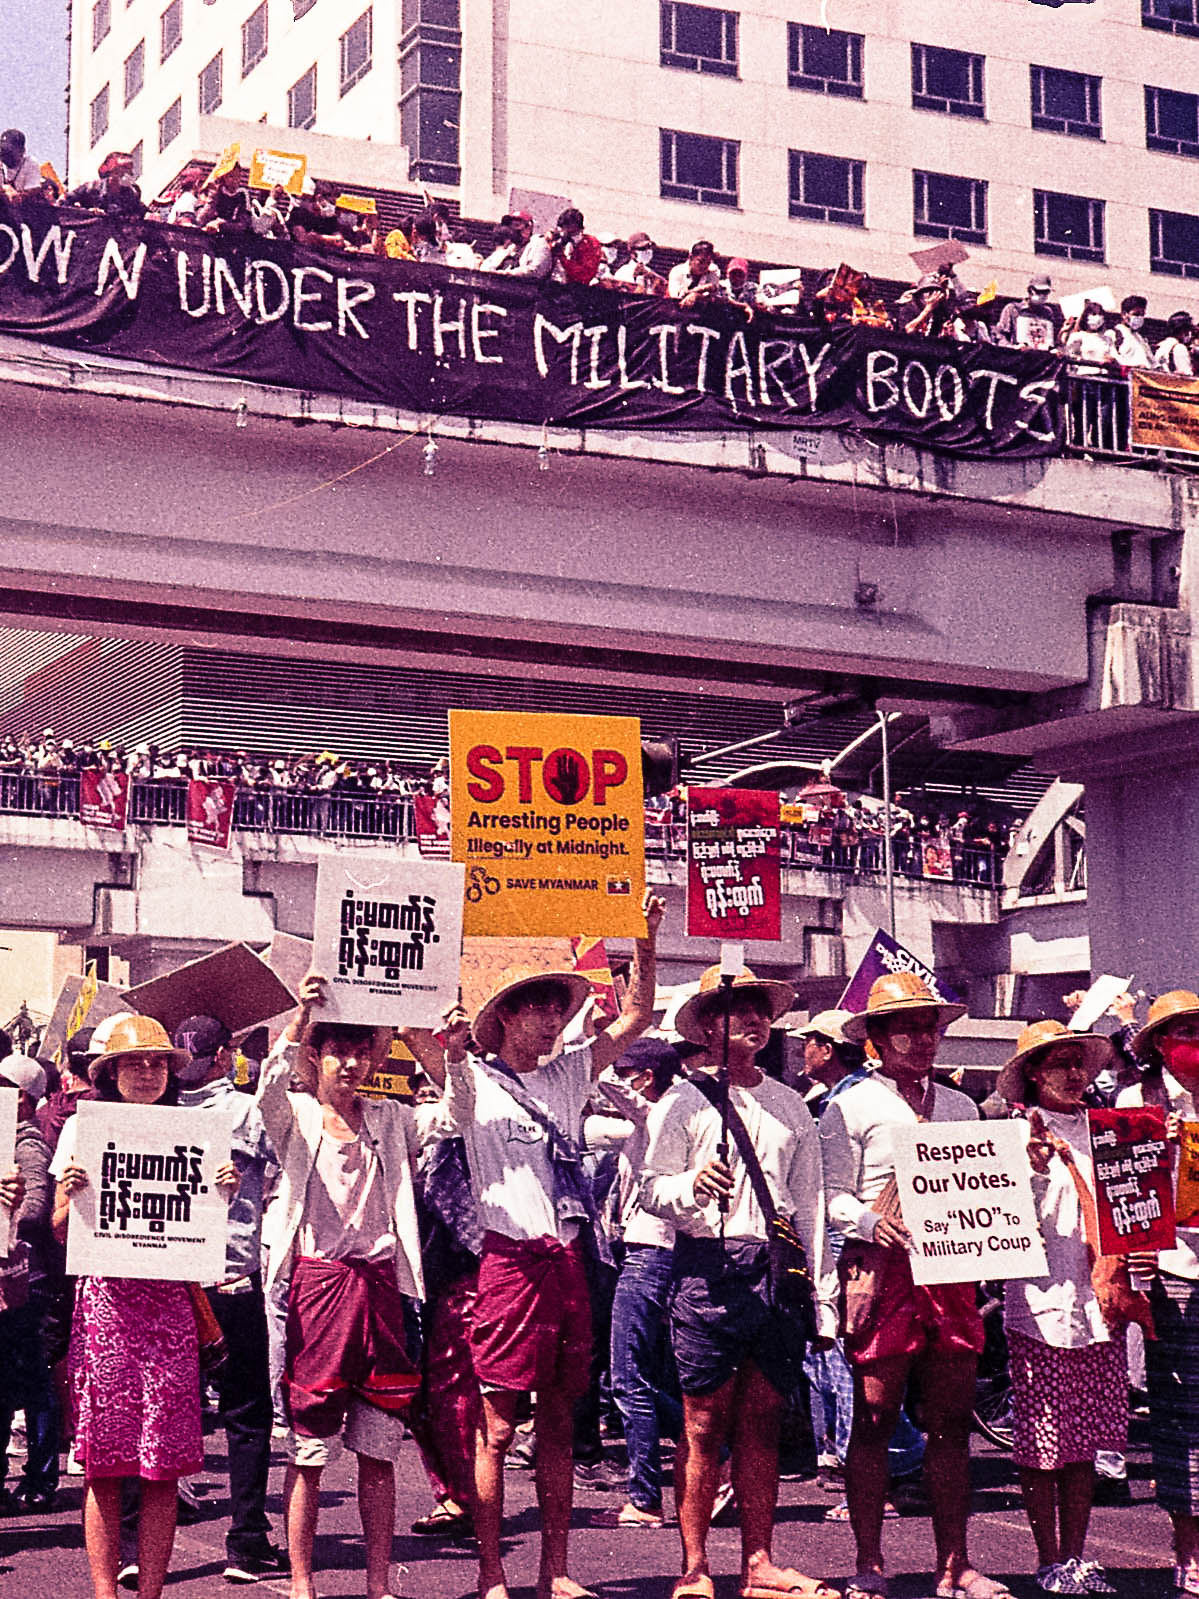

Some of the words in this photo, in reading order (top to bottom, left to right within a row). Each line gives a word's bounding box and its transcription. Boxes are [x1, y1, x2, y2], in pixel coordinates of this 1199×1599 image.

[177, 250, 376, 339] UNDER
[392, 289, 507, 363] THE
[534, 313, 832, 415] MILITARY
[866, 350, 1058, 442] BOOTS
[466, 744, 628, 806] STOP
[467, 811, 560, 835] Arresting
[565, 813, 630, 836] People
[467, 838, 533, 858] Illegally
[536, 841, 553, 854] at
[556, 839, 629, 859] Midnight.
[506, 878, 536, 889] SAVE
[538, 879, 599, 890] MYANMAR
[896, 949, 940, 994] CIVIL
[915, 1139, 996, 1164] Respect
[912, 1175, 950, 1195] Our
[952, 1171, 1016, 1191] Votes.
[94, 1231, 112, 1239] CIVIL
[923, 1219, 949, 1235] Say
[1003, 1213, 1020, 1226] To
[922, 1240, 983, 1257] Military
[987, 1236, 1031, 1252] Coup
